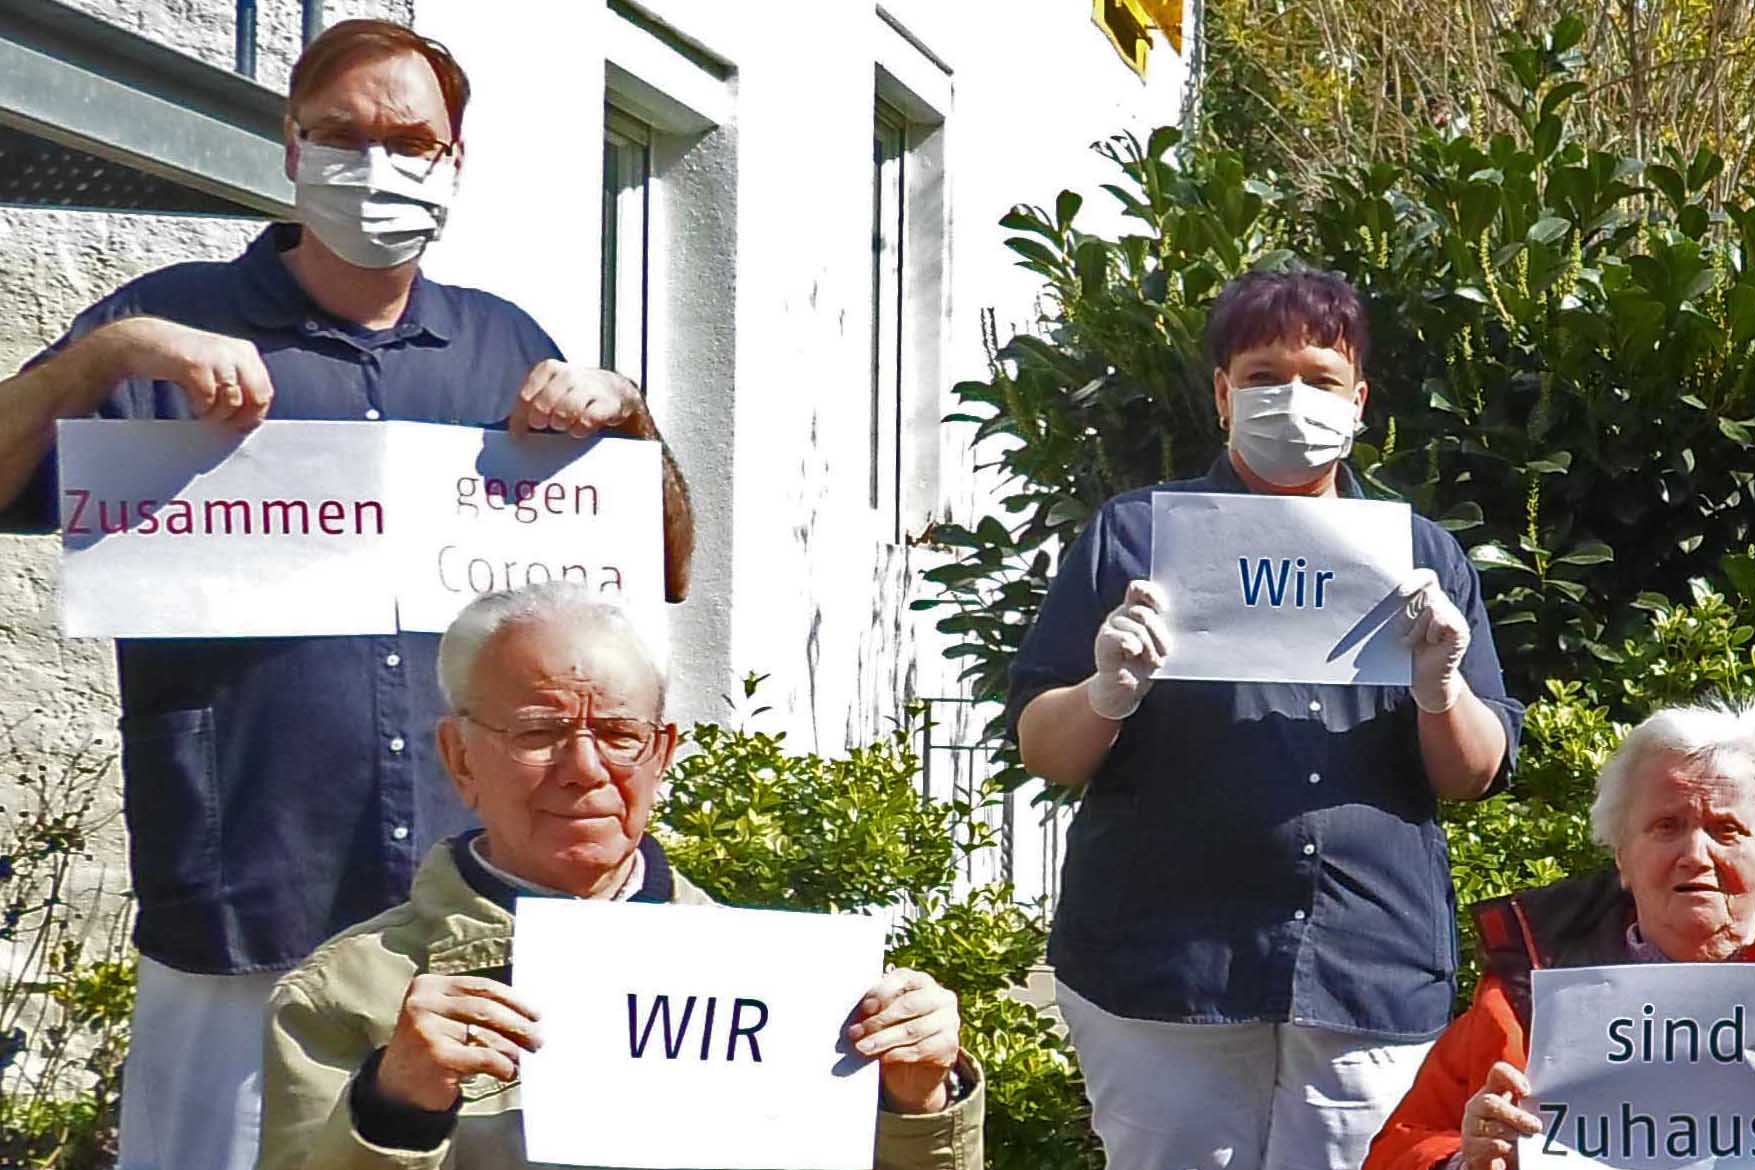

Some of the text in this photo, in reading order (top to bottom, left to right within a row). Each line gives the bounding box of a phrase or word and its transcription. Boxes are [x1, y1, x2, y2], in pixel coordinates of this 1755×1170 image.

[65, 490, 386, 537] Zusammen
[456, 475, 600, 524] gegen
[1239, 557, 1335, 609] Wir
[626, 993, 769, 1063] WIR
[1607, 1004, 1745, 1062] sind
